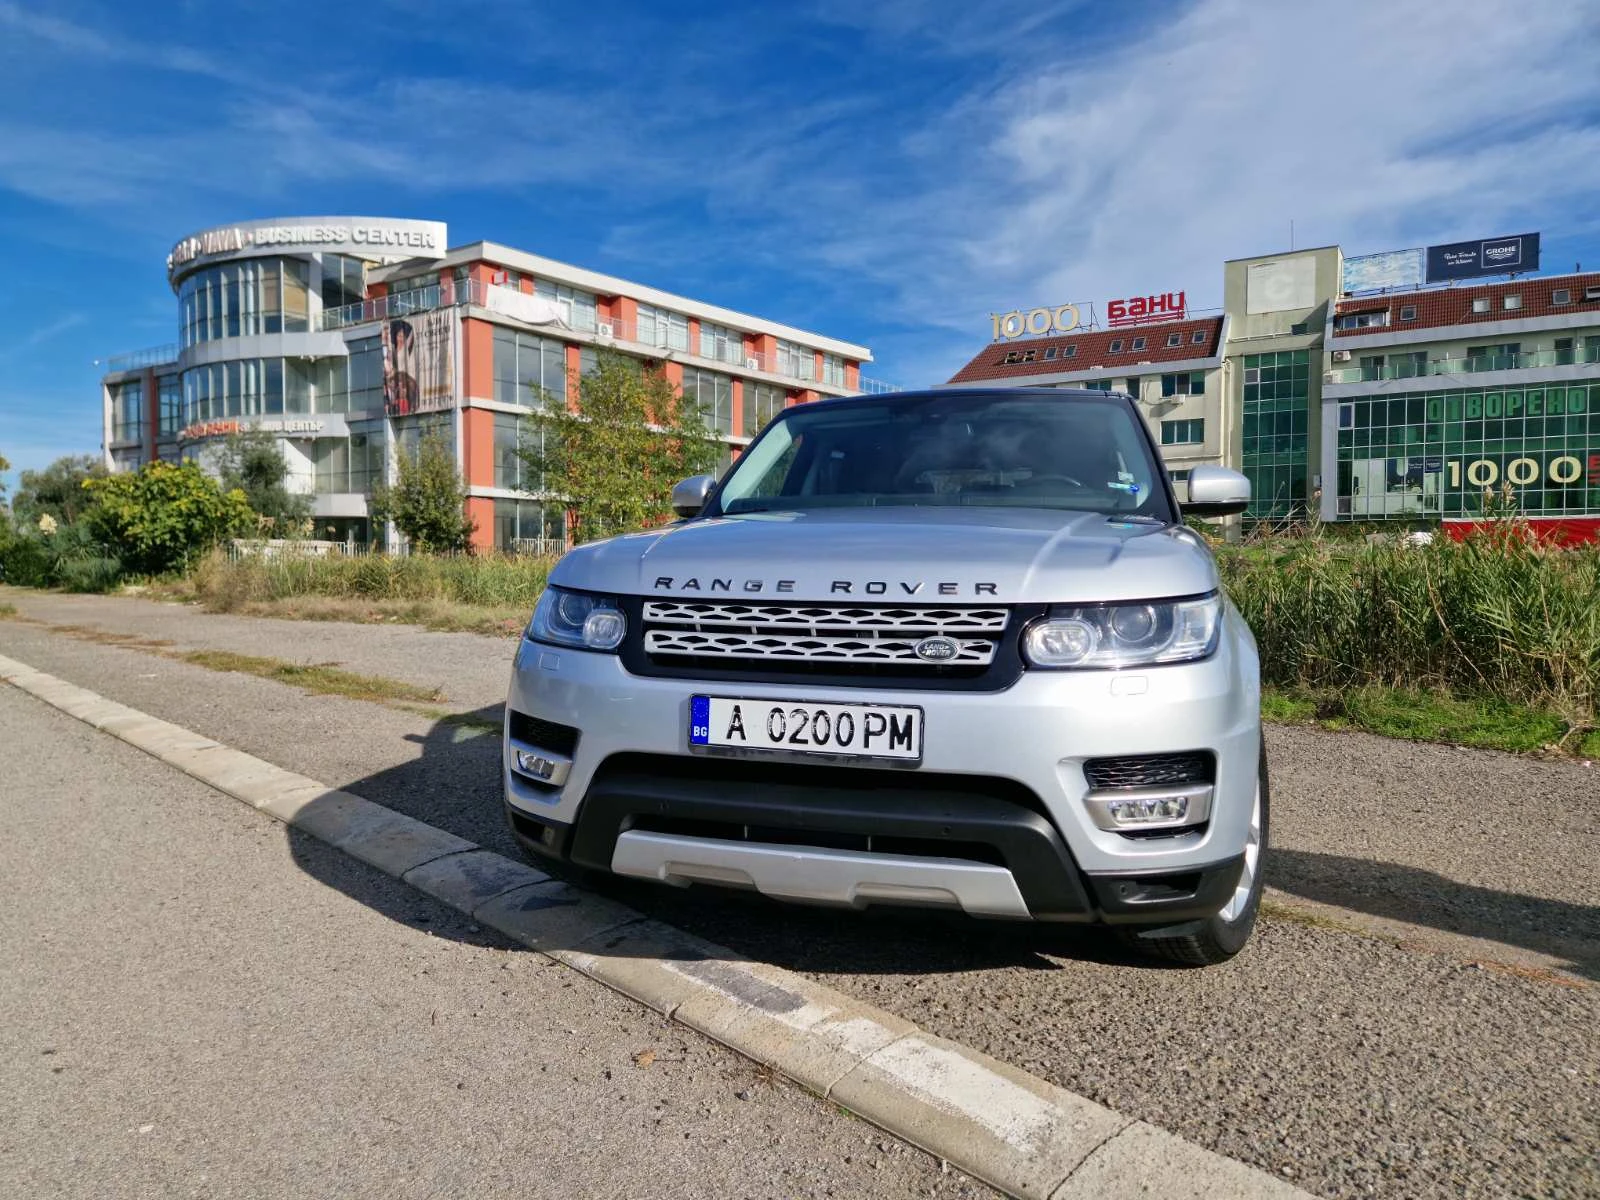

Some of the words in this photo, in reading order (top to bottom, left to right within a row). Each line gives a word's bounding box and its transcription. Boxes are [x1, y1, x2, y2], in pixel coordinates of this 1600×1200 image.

[255, 226, 348, 245] BUSINESS
[352, 227, 435, 248] CENTER
[1486, 245, 1517, 255] GROHE
[990, 303, 1080, 340] 1000
[1427, 389, 1586, 422] ОТВОРЕНО
[1447, 455, 1582, 488] 1000
[653, 576, 796, 593] RANGE
[830, 580, 998, 595] ROVER
[693, 725, 708, 737] BG
